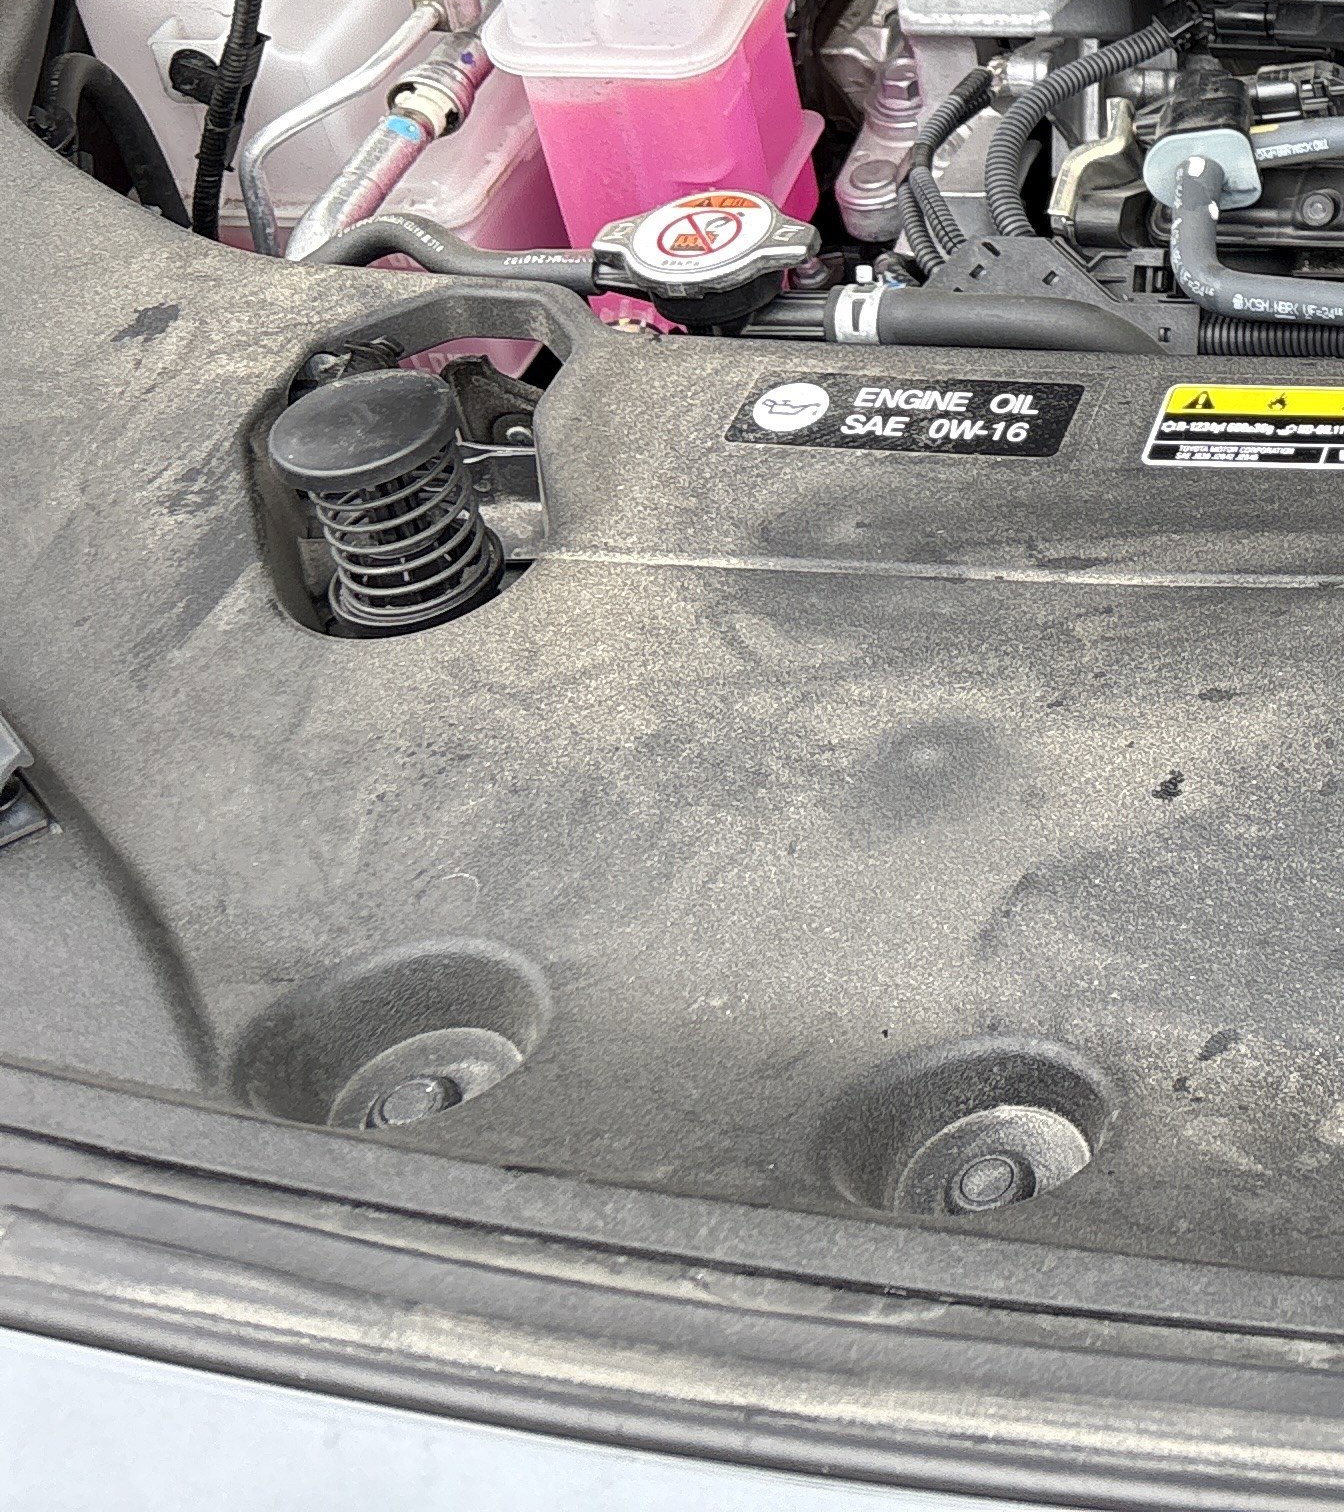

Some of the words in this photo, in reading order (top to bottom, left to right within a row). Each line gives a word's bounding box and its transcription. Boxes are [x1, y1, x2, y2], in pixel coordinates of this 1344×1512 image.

[854, 388, 972, 412] ENGINE
[989, 393, 1039, 415] OIL
[840, 416, 910, 437] SAE
[928, 418, 1029, 442] 0W-16
